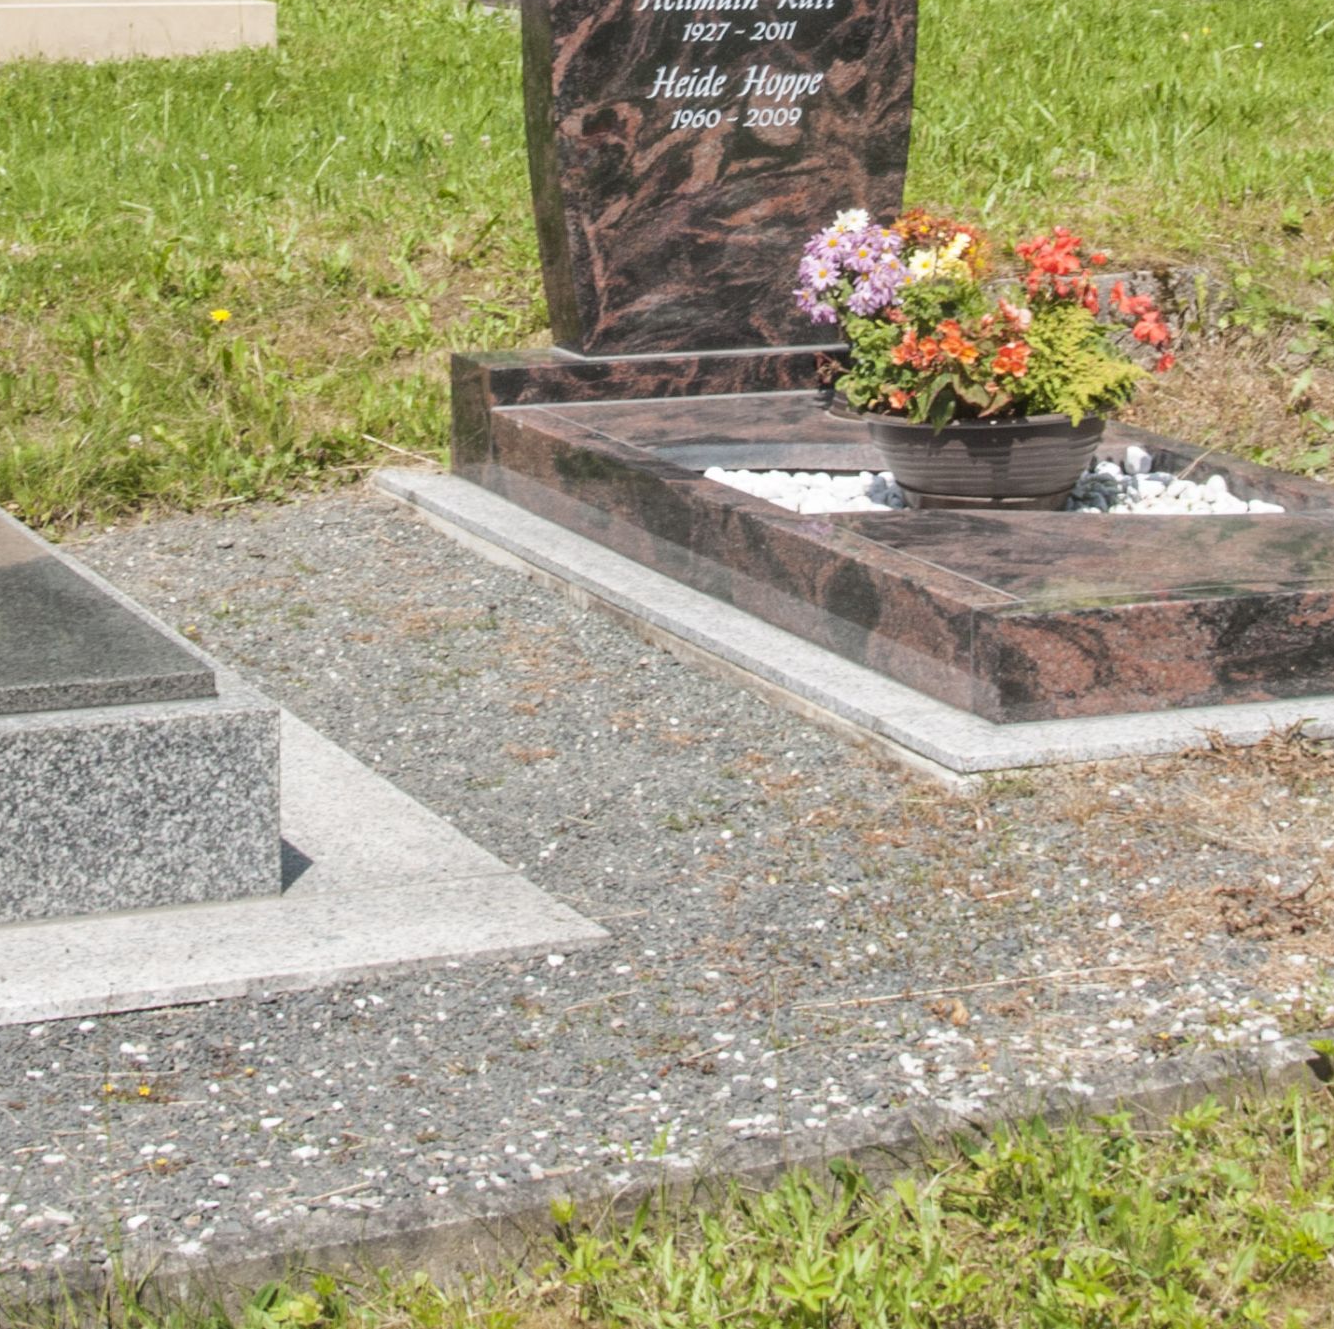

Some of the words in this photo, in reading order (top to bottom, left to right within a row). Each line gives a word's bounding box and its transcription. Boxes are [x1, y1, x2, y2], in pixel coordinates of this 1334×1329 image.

[682, 22, 731, 42] 1927
[750, 21, 798, 41] 2011
[646, 65, 728, 99] Heide
[737, 64, 824, 103] Hoppe
[670, 109, 722, 129] 1960
[743, 108, 802, 128] 2009
